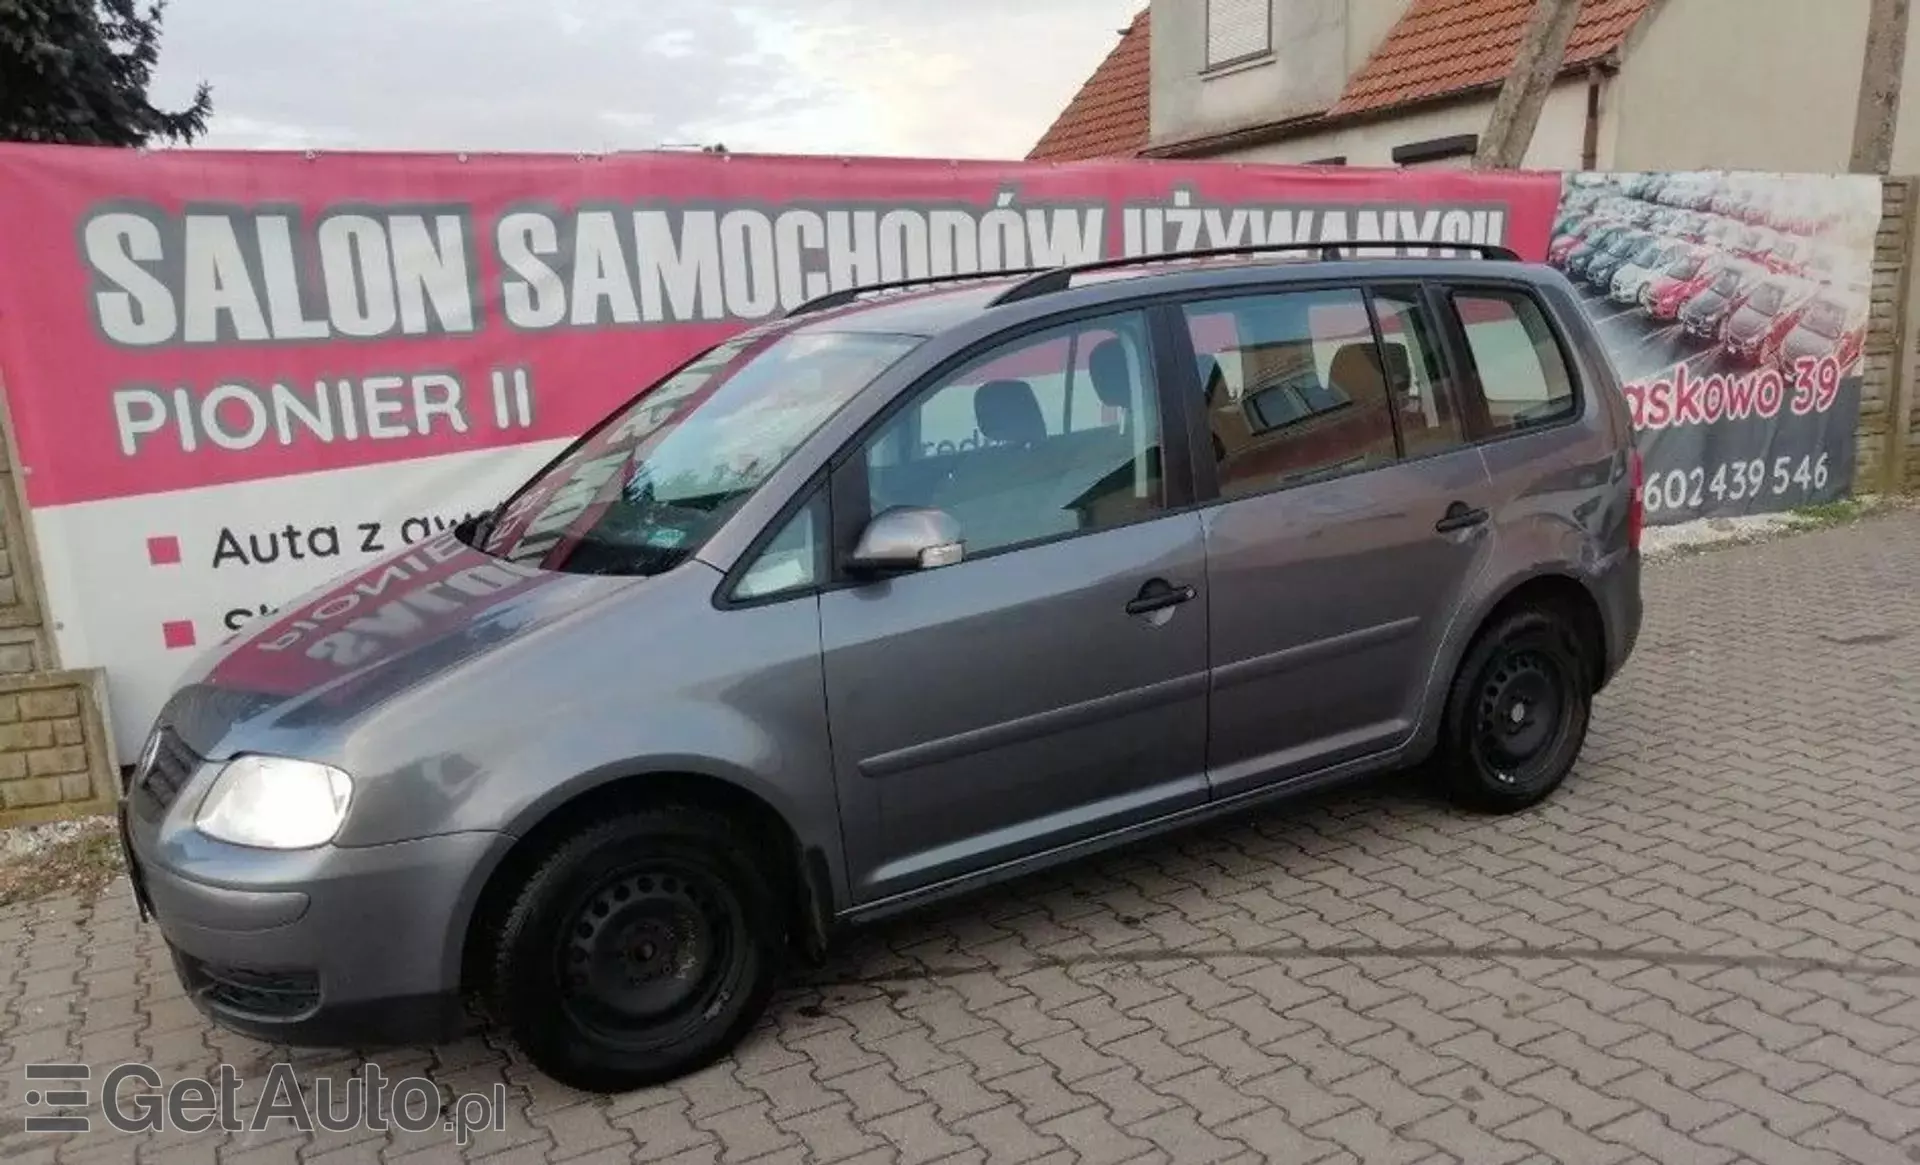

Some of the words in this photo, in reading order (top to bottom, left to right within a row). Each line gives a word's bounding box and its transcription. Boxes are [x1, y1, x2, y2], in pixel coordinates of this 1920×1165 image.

[83, 209, 475, 346] SALON
[498, 192, 1105, 329] SAMOCHODÓW
[113, 372, 468, 456] PIONIER
[492, 368, 531, 428] II
[1791, 355, 1840, 415] 39
[1643, 466, 1705, 512] 602
[1709, 459, 1765, 501] 439
[1772, 451, 1829, 495] 546
[212, 525, 340, 569] Auta
[357, 522, 385, 552] z
